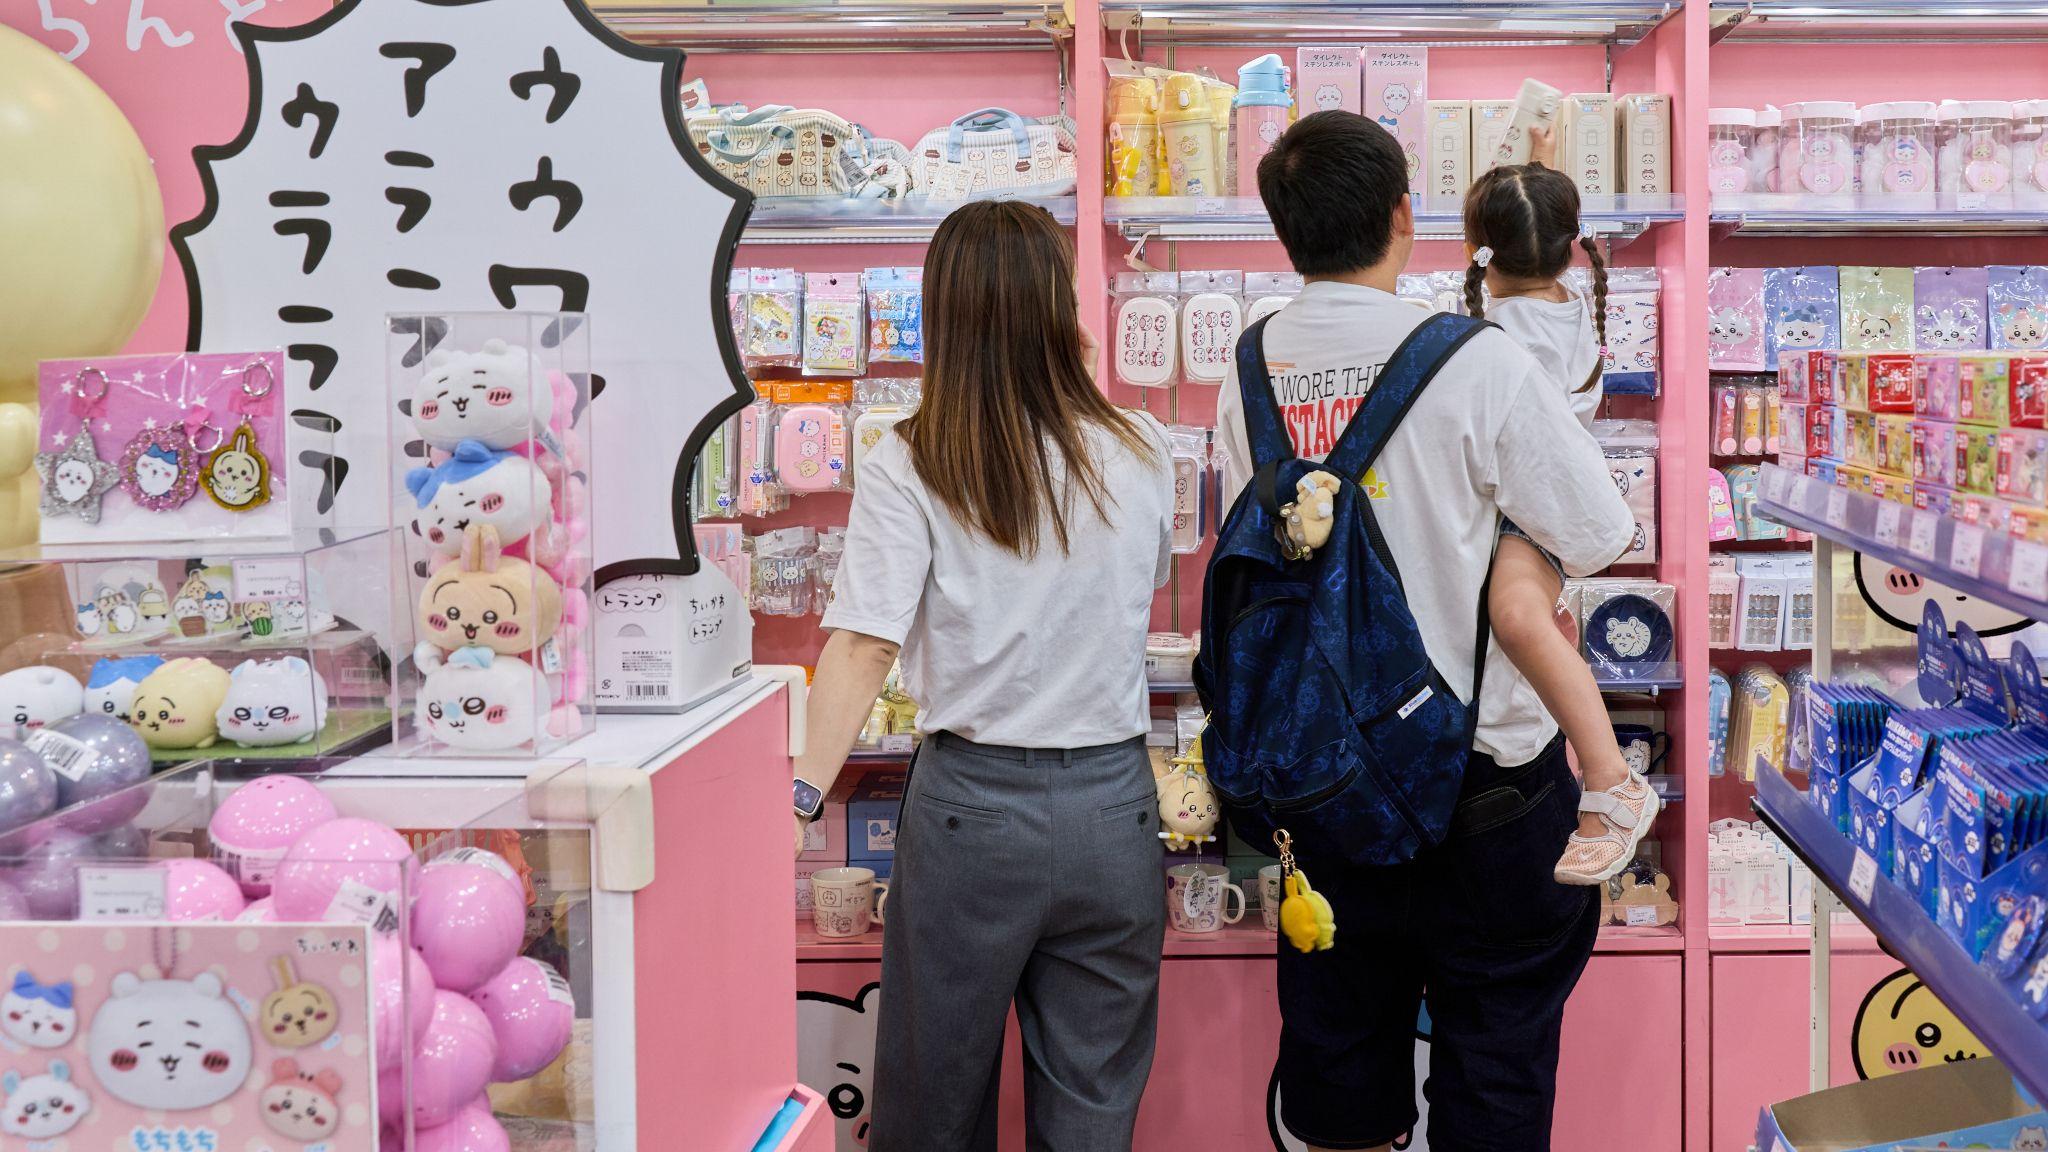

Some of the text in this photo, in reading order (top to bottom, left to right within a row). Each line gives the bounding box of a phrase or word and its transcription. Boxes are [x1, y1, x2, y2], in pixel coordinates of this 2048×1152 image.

[1314, 53, 1343, 61] ダイレクト
[1281, 369, 1335, 404] WORE
[604, 593, 662, 608] トランプ
[693, 619, 722, 639] トランプ
[134, 1129, 215, 1152] もちもち
